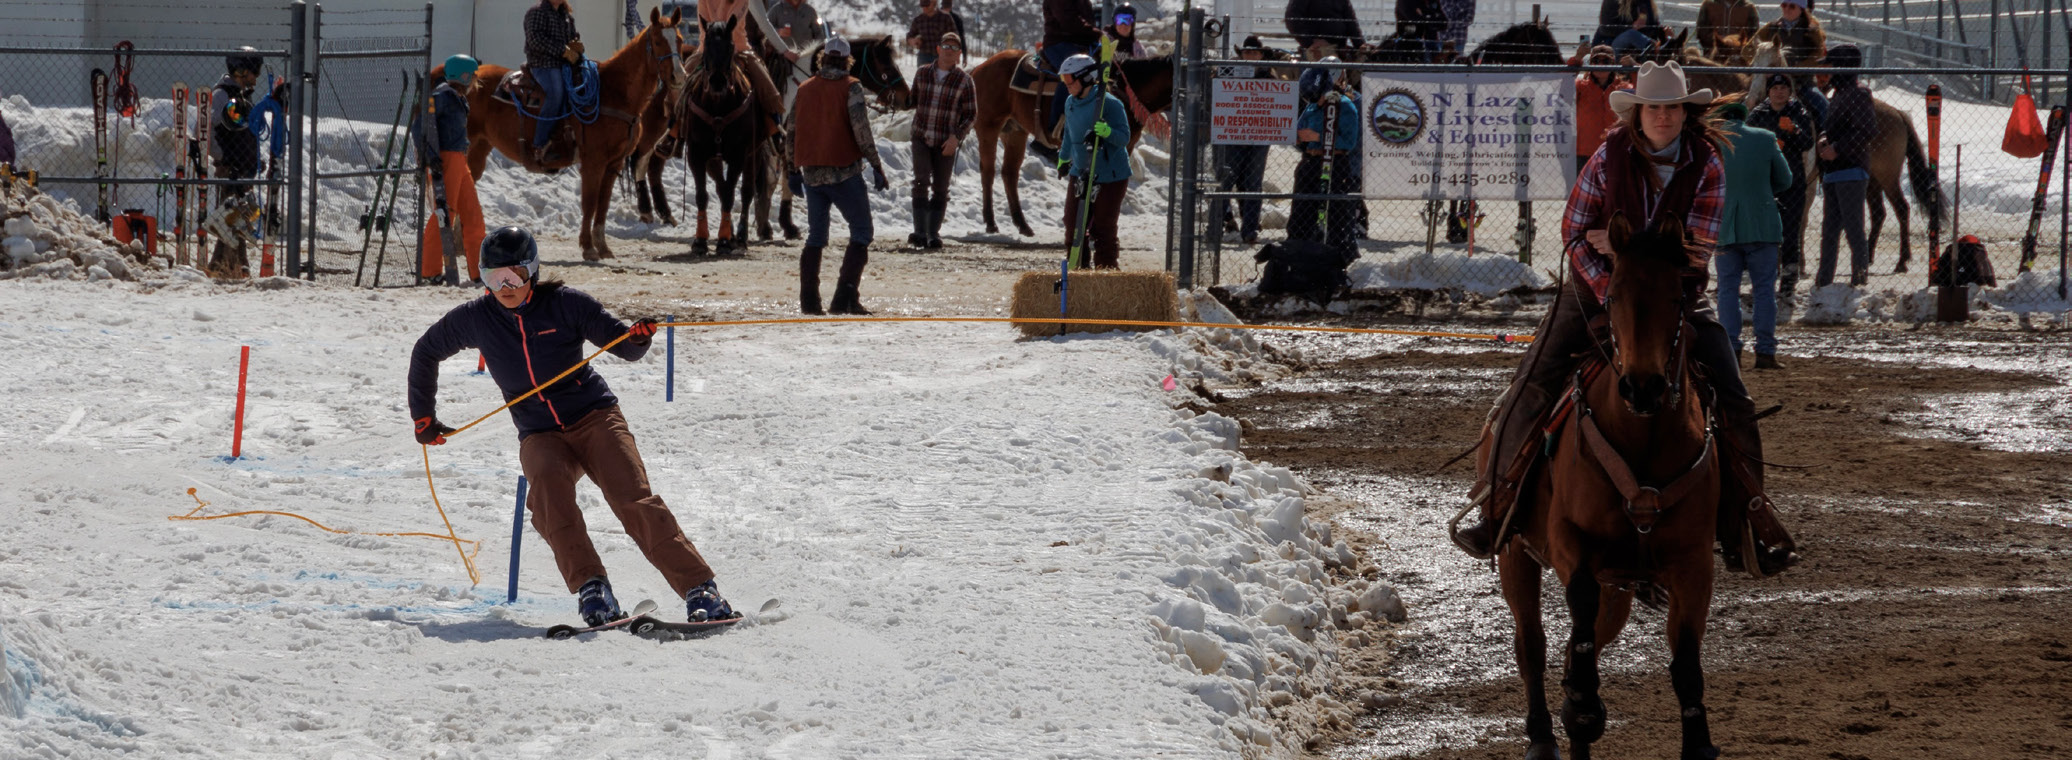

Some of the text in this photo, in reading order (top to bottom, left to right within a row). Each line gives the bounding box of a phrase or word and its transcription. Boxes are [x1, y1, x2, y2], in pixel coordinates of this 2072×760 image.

[1222, 81, 1291, 92] WARNING
[97, 83, 105, 132] HEAD
[1431, 93, 1454, 107] N
[1465, 93, 1535, 110] Lazy
[1214, 116, 1293, 128] NO RESPONSIBILITY
[1436, 110, 1572, 125] Livestock
[1324, 105, 1336, 160] HEAD
[1428, 128, 1568, 148] & Equipment
[1416, 151, 1459, 159] Welding,
[1408, 171, 1530, 187] 406-425-0289
